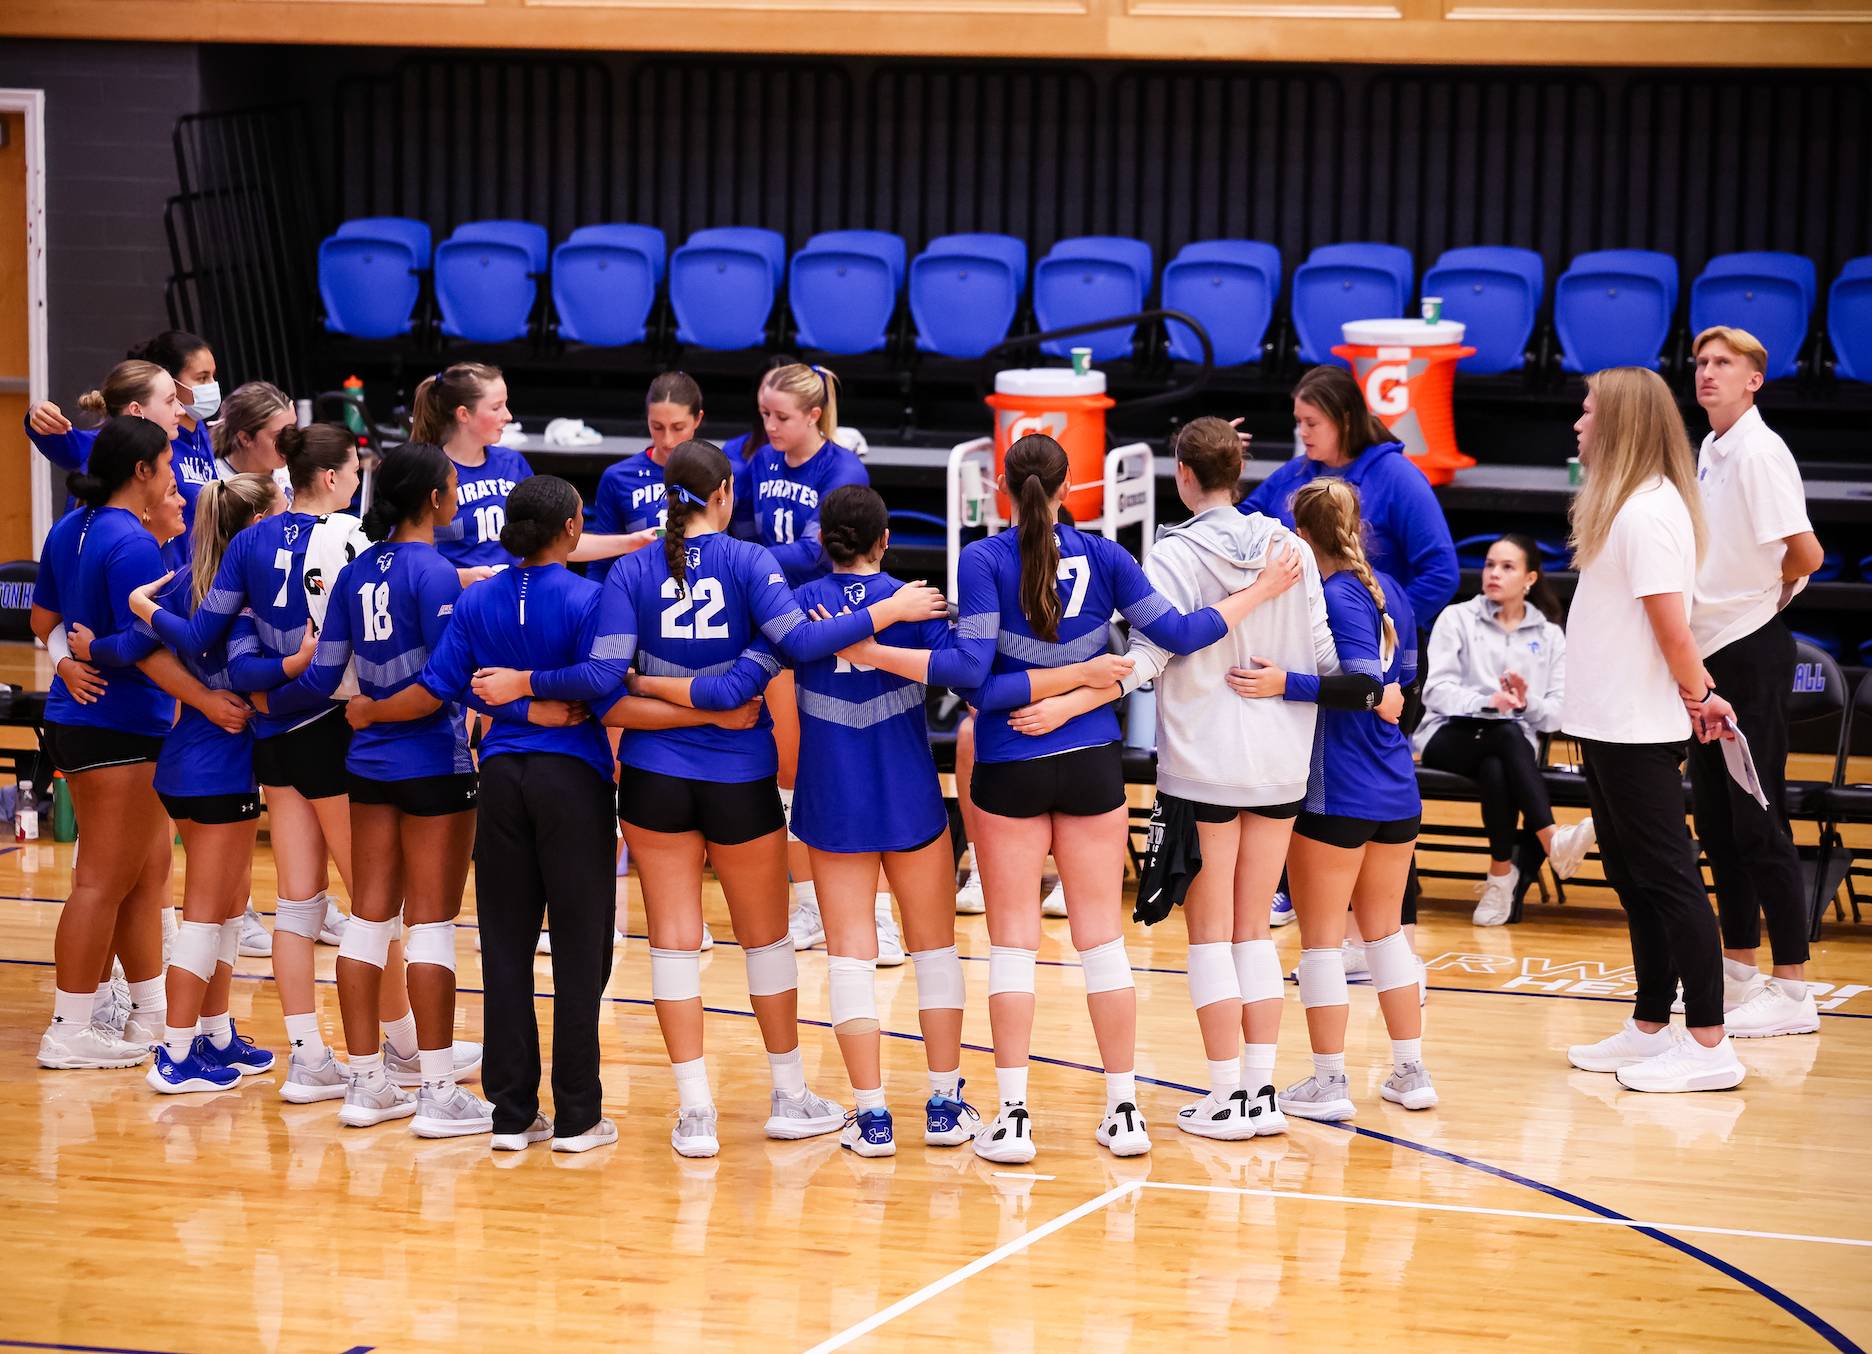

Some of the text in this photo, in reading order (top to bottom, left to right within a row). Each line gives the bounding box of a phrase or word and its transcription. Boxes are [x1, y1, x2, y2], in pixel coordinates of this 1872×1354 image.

[1366, 366, 1408, 415] G
[456, 478, 517, 506] IRATES
[759, 479, 819, 509] PIRATES
[473, 504, 505, 544] 10
[773, 507, 795, 545] 11
[272, 548, 293, 608] 7
[1053, 555, 1092, 619] 7
[357, 581, 394, 641] 18
[661, 577, 729, 639] 22
[1792, 662, 1826, 692] ALL
